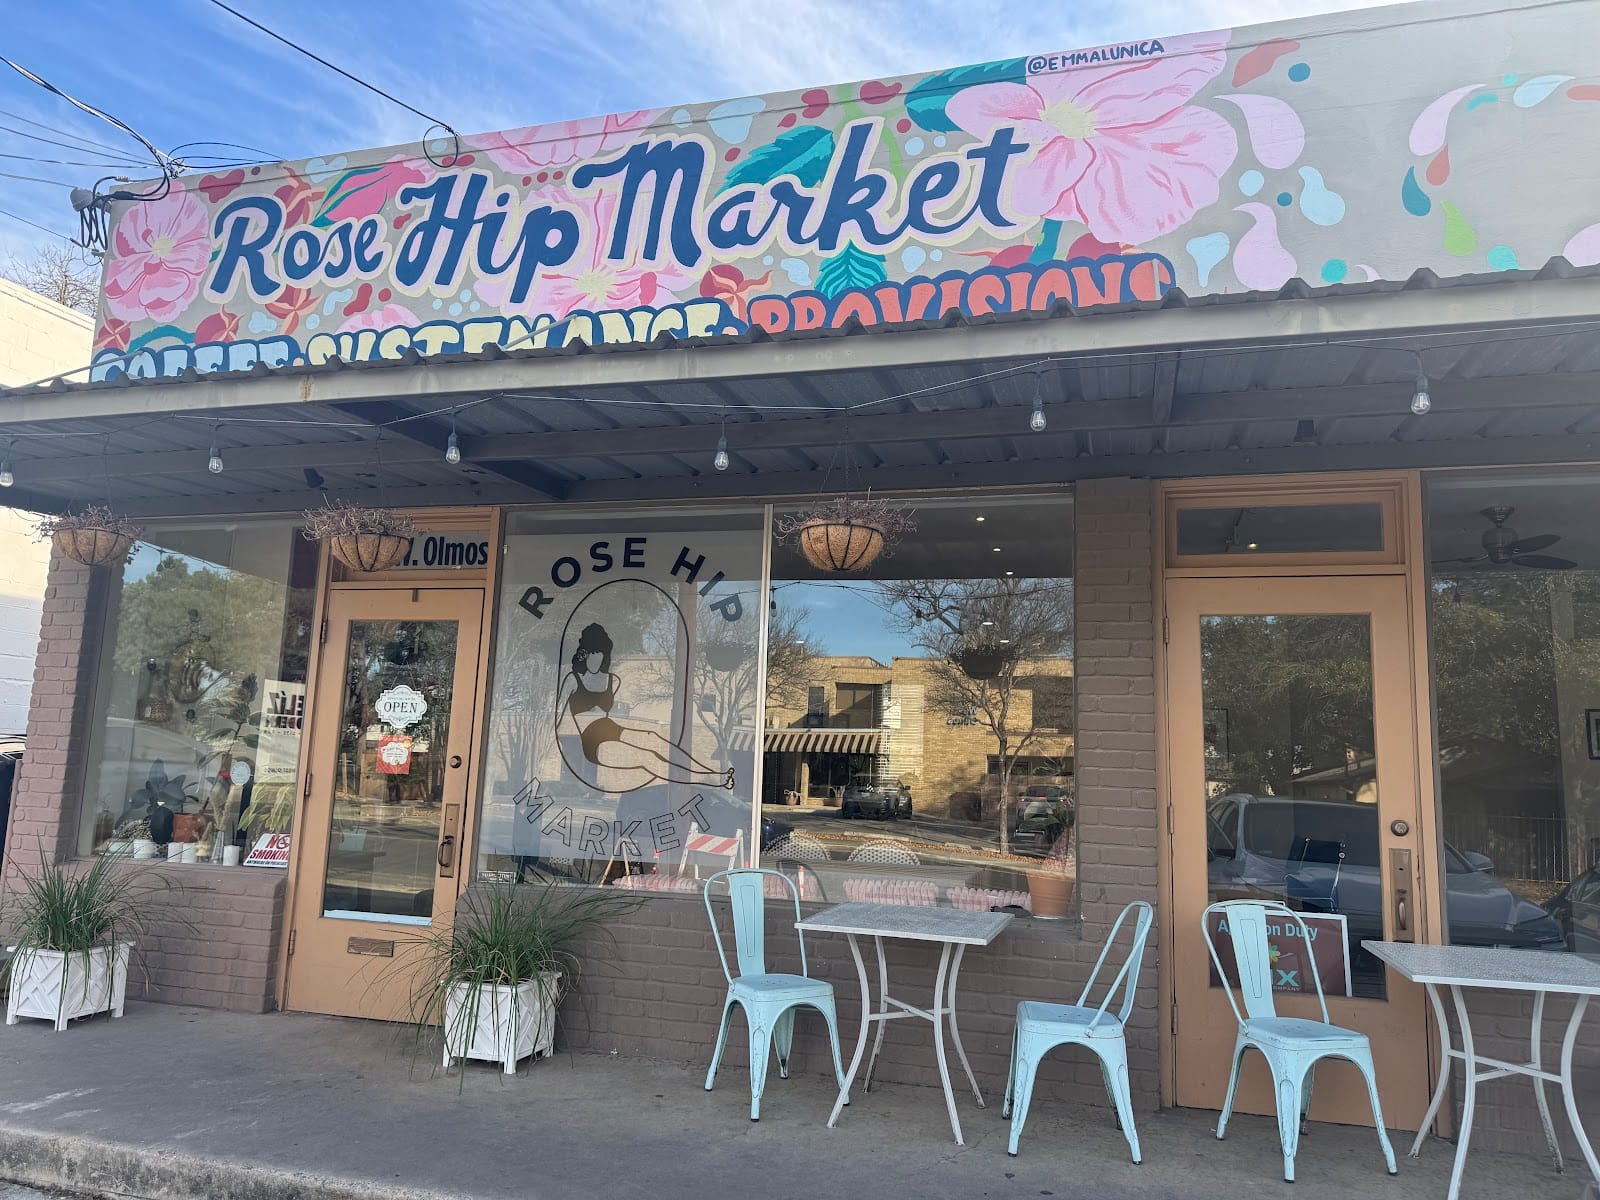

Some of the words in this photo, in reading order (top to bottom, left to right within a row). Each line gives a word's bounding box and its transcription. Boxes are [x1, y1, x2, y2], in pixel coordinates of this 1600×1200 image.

[1028, 40, 1165, 75] @EMMALUNICA
[209, 196, 384, 297] Rose
[395, 172, 580, 304] Hip
[572, 123, 1030, 268] Market
[307, 299, 724, 365] SUSTENANCE
[424, 536, 489, 566] Olmos
[518, 537, 647, 620] ROSE
[670, 546, 743, 622] HIP
[383, 701, 418, 713] OPEN
[513, 776, 711, 857] MARKET
